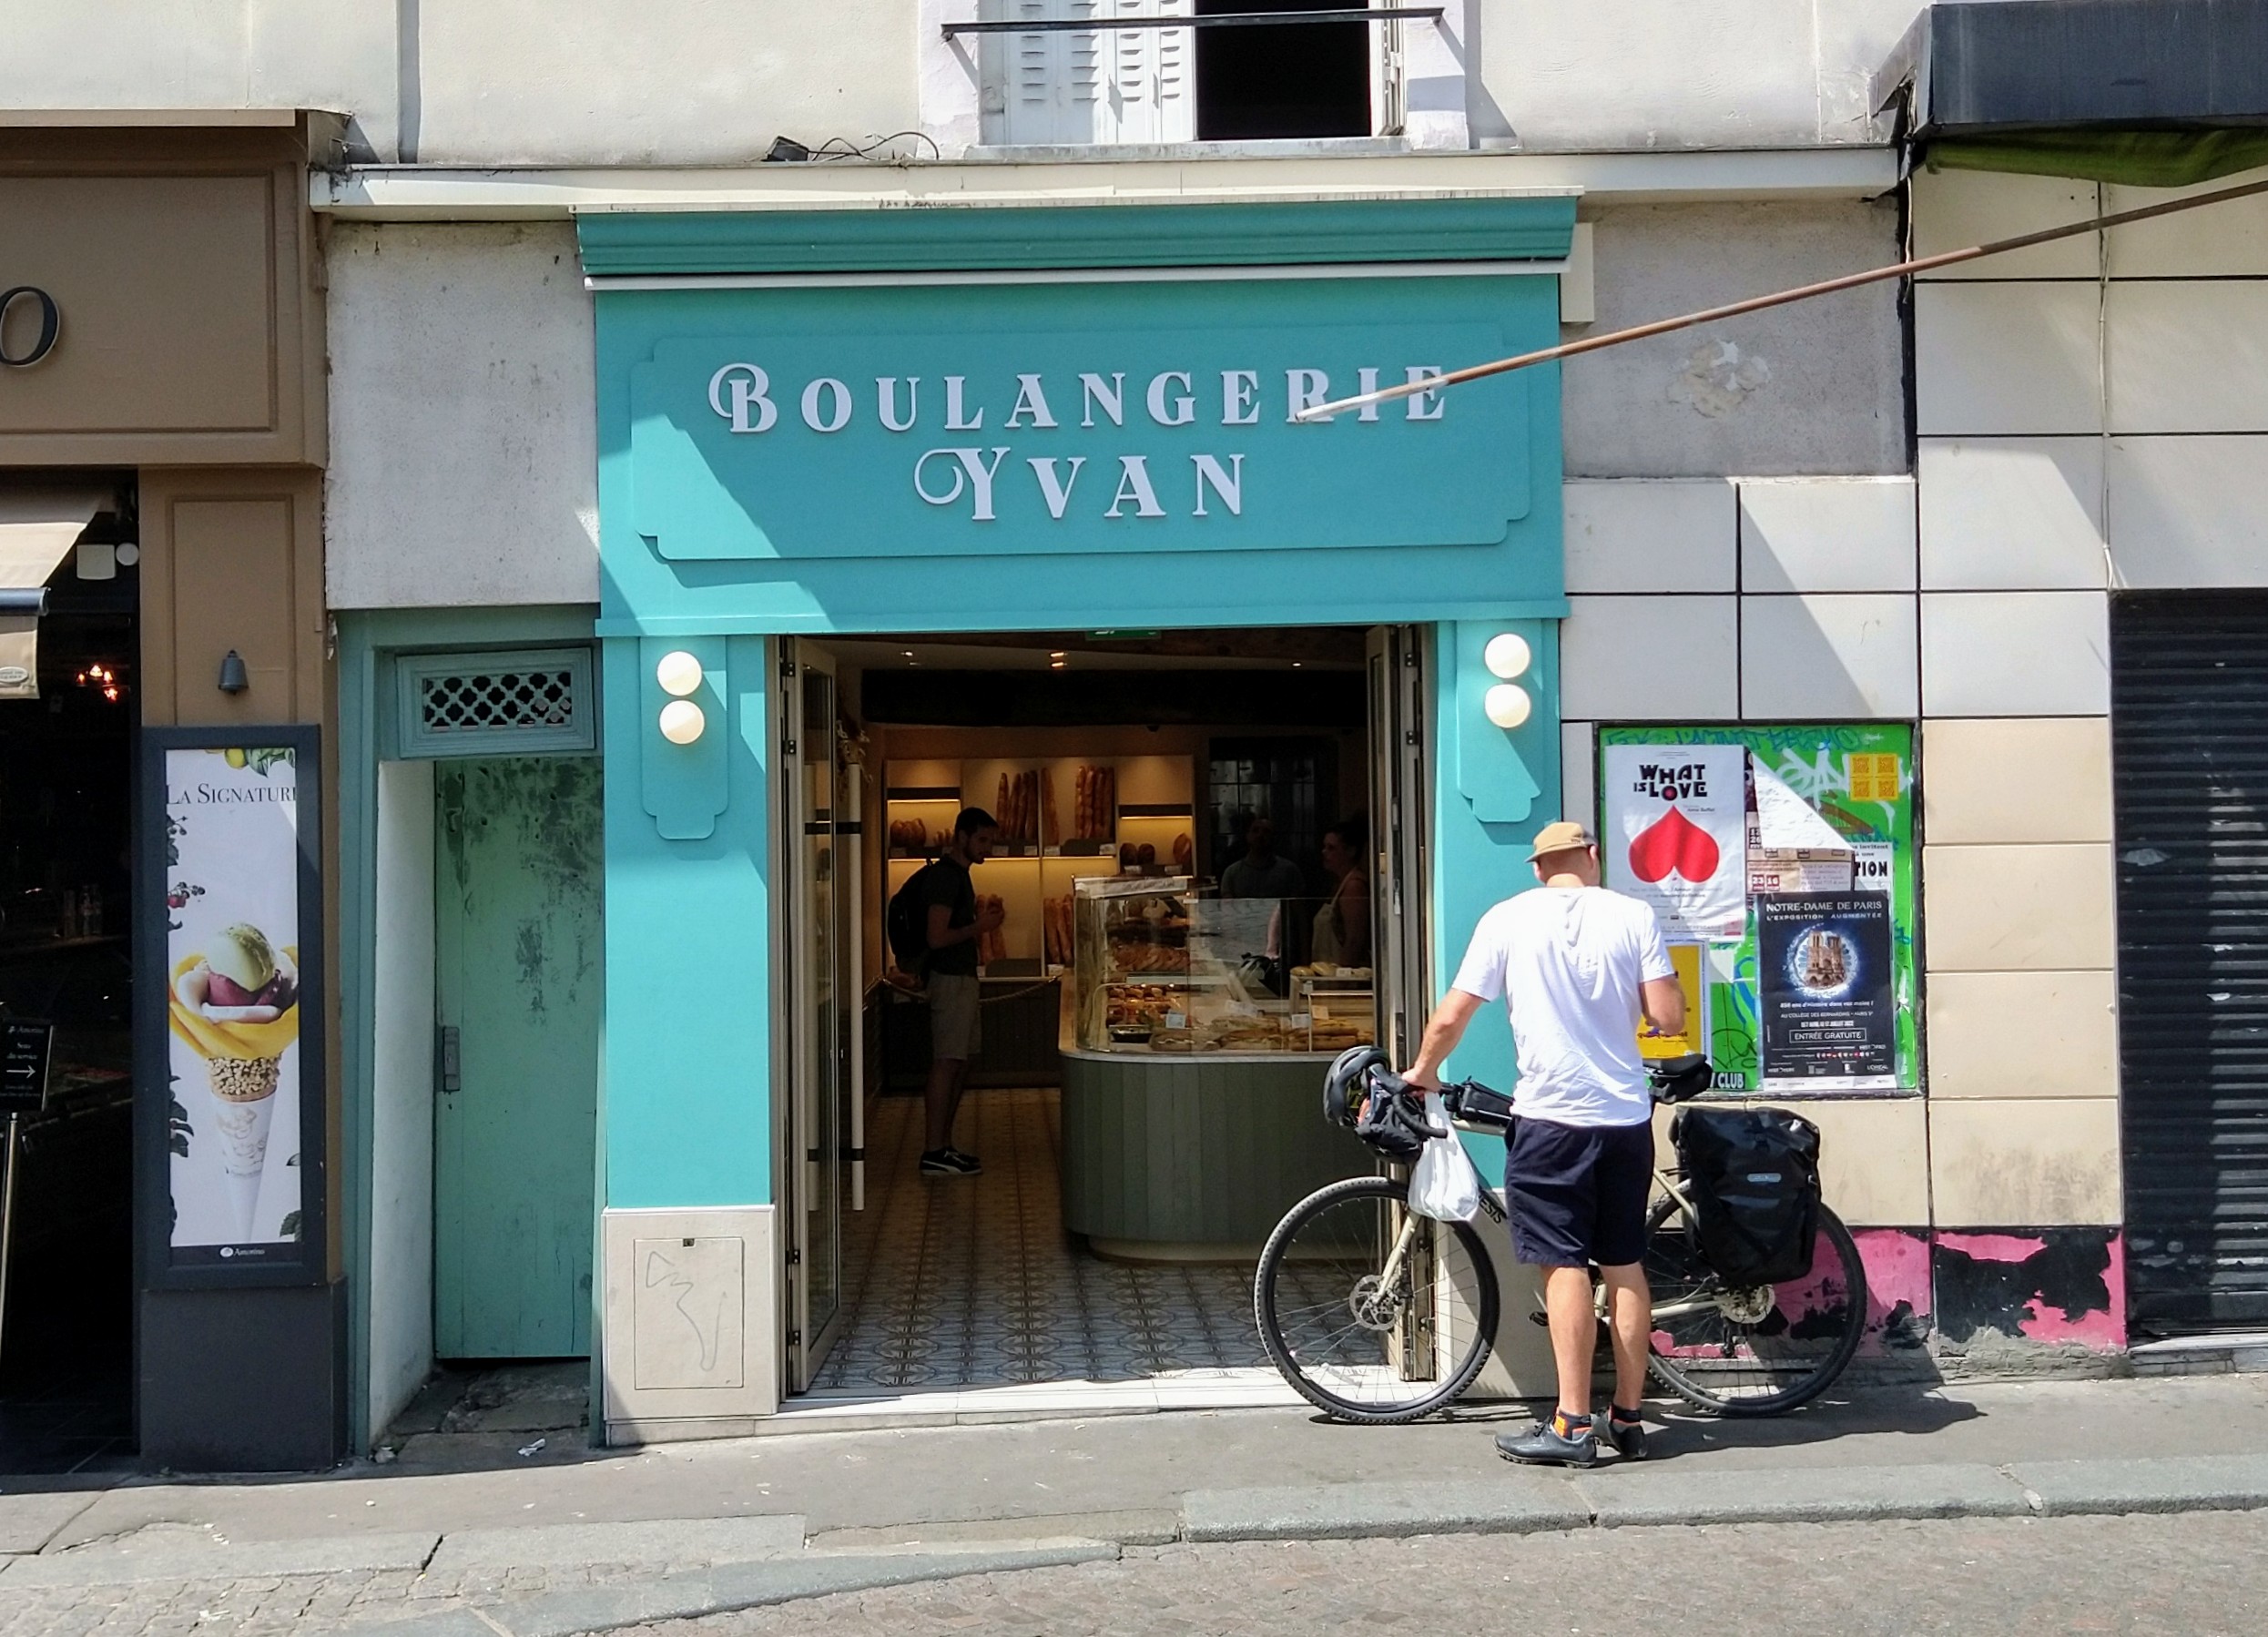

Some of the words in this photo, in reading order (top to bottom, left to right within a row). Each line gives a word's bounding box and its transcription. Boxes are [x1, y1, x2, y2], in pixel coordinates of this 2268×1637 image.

[708, 362, 1446, 433] BOULANGERIE
[914, 447, 1245, 520] YVAN
[1639, 764, 1705, 784] WHAT
[167, 784, 191, 804] LA
[1633, 782, 1646, 792] IS
[1649, 781, 1707, 801] LOVE
[1854, 861, 1887, 877] TION
[1766, 902, 1833, 912] NOTRE-DAME
[1837, 901, 1851, 910] DE
[1854, 901, 1882, 910] PARIS
[1795, 1032, 1822, 1040] ENTRÉE
[1824, 1031, 1861, 1039] GRATUITE
[1717, 1072, 1744, 1089] CLUB
[1478, 1193, 1502, 1224] ESIS
